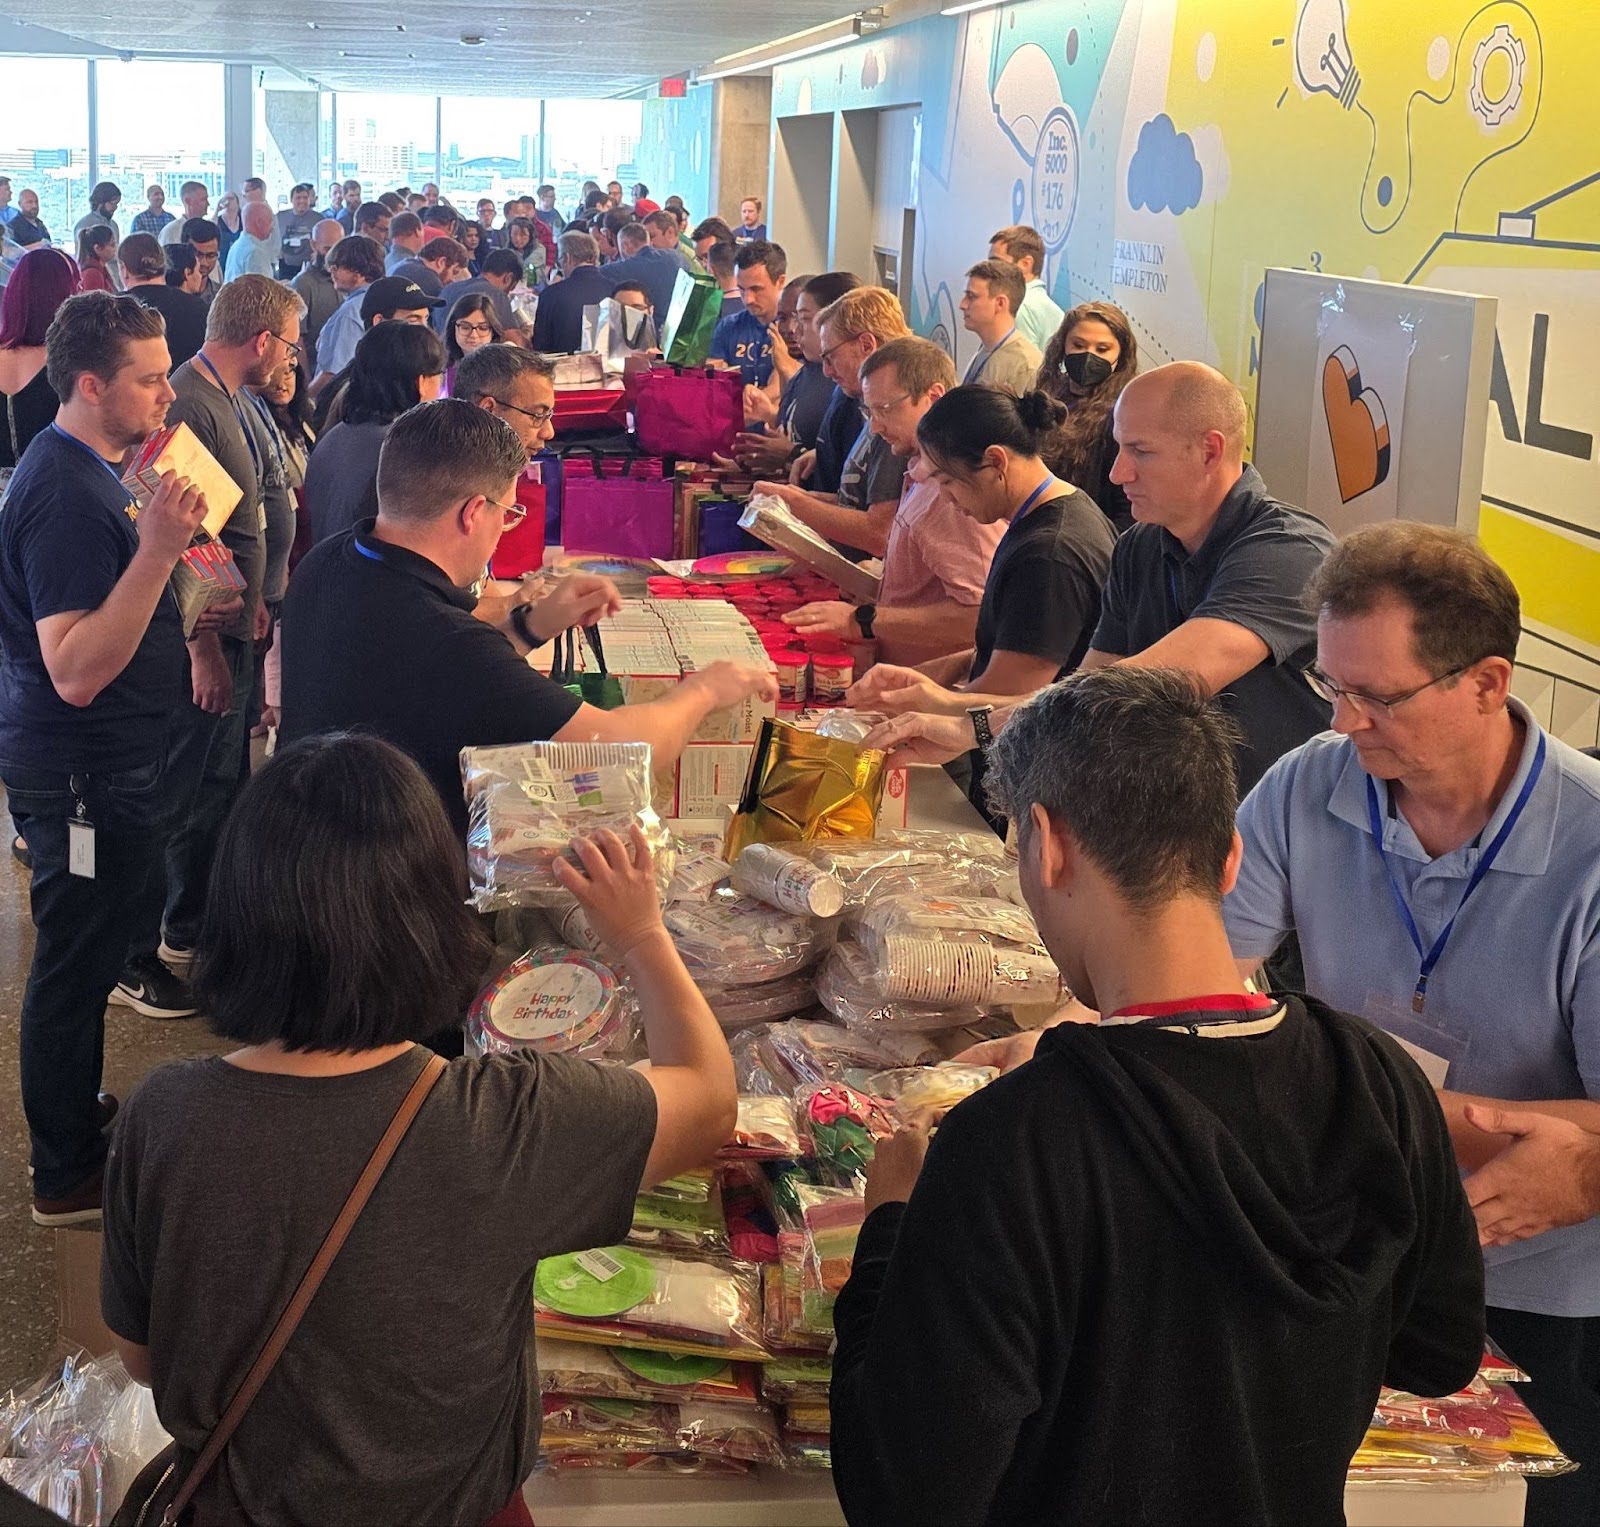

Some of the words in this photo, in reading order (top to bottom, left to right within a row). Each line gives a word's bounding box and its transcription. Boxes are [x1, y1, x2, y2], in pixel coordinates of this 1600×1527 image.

[1048, 131, 1067, 151] Inc.
[1045, 153, 1068, 174] 5000
[1114, 240, 1165, 265] FRANKLIN
[1109, 265, 1168, 294] TEMPLETON
[745, 710, 753, 734] Moist
[529, 993, 575, 1005] Happy
[512, 1007, 574, 1020] Birthday
